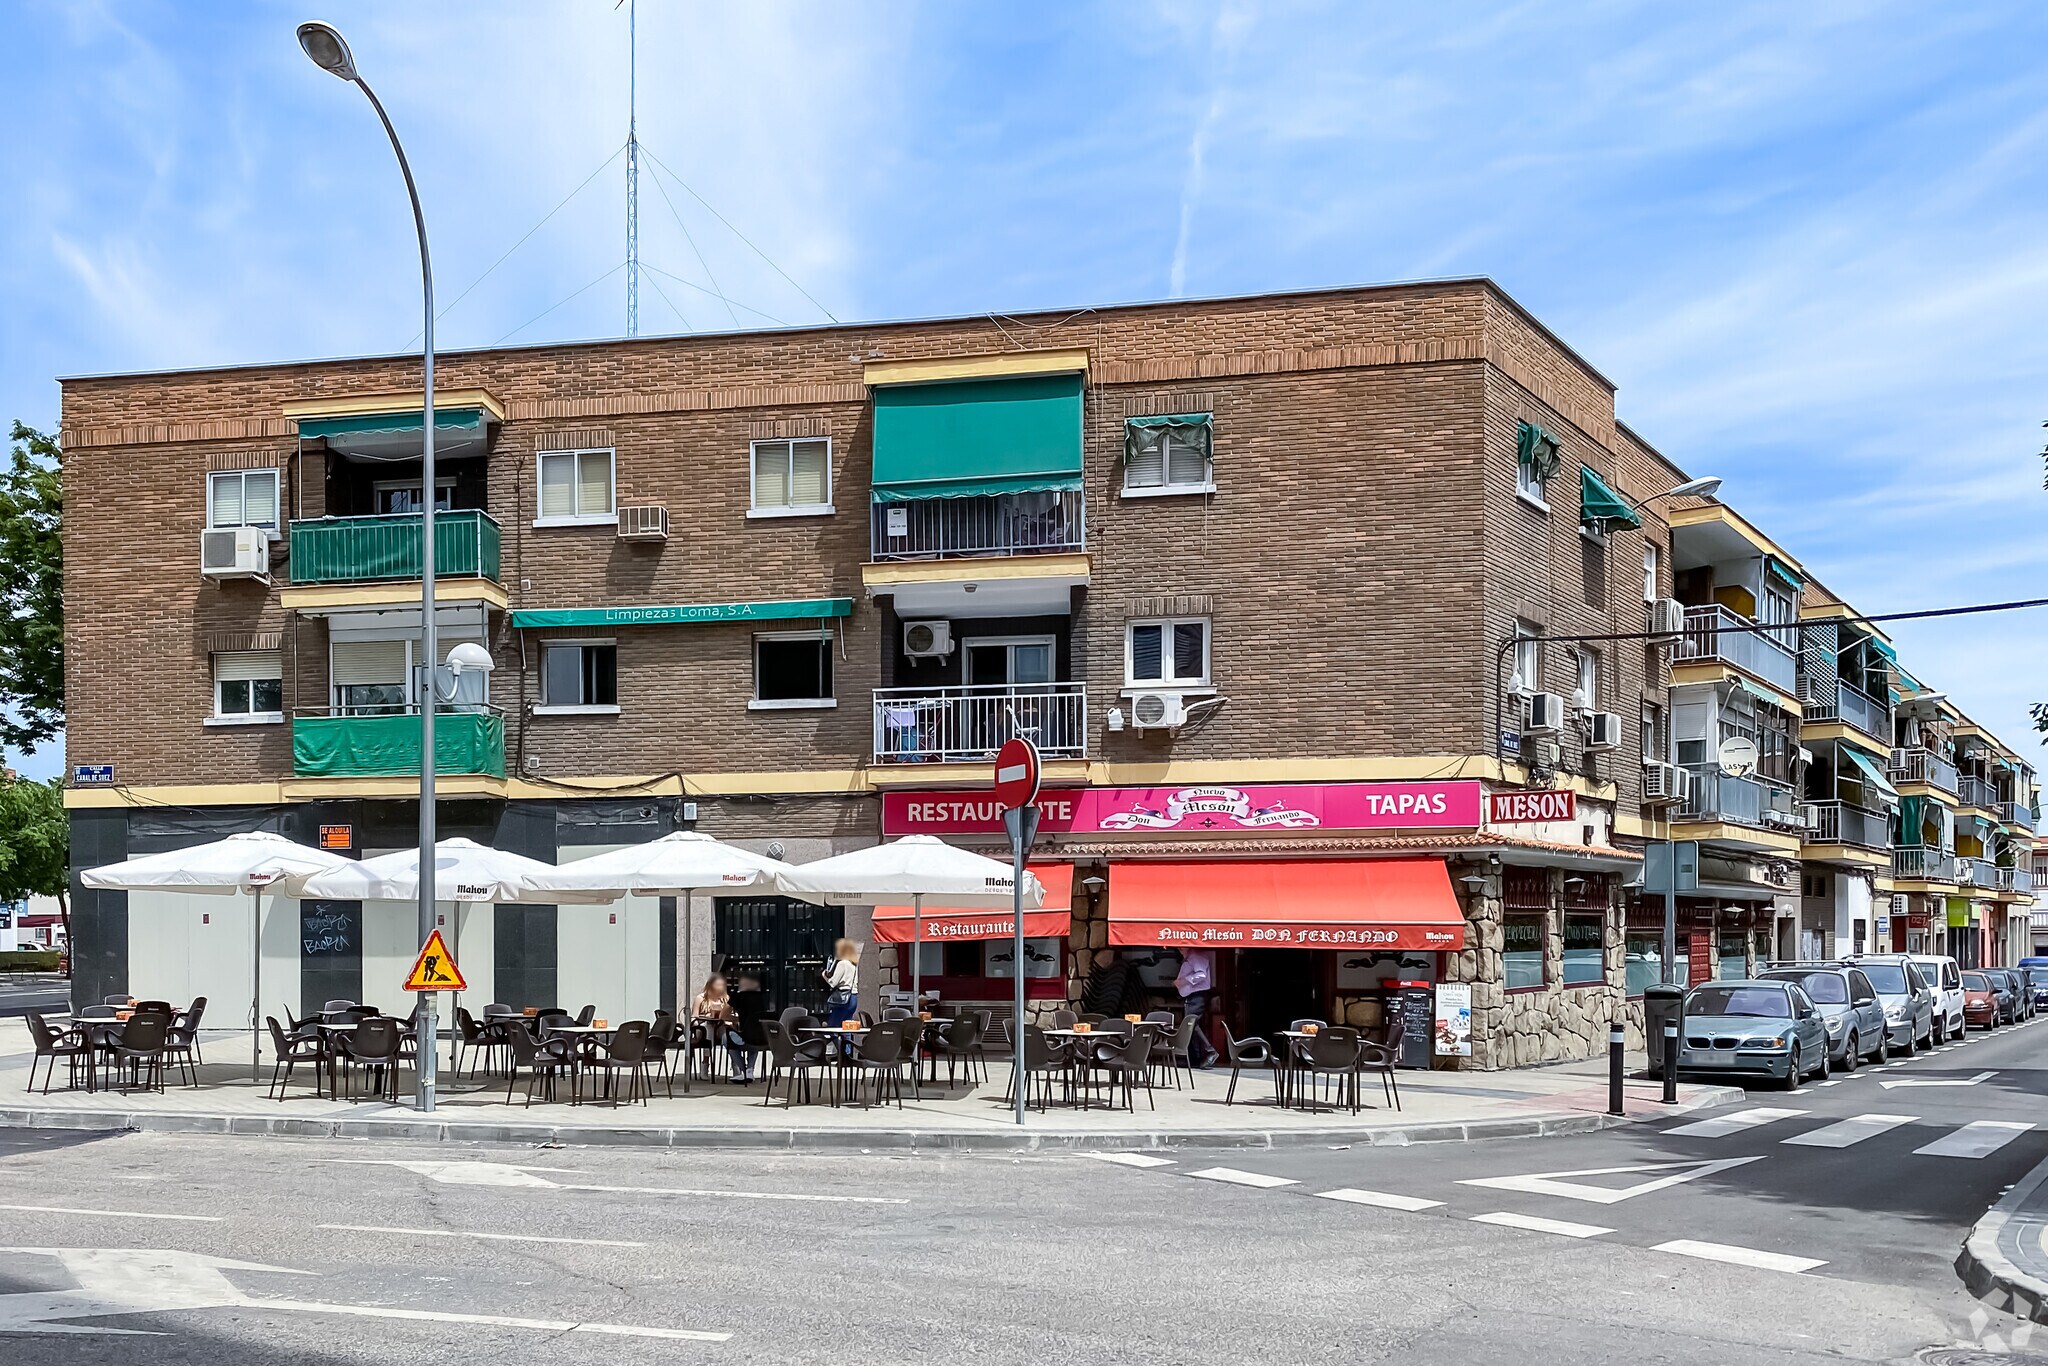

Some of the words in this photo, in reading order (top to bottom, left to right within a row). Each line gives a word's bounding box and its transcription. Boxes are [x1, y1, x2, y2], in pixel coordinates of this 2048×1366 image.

[606, 609, 676, 622] Limpiezas
[680, 606, 724, 618] Loma,
[728, 604, 757, 616] S.A.
[1193, 789, 1226, 797] Nuevo
[908, 801, 1071, 822] RESTAURTE
[1366, 793, 1447, 815] TAPAS
[1494, 793, 1570, 821] MESON
[1127, 814, 1151, 825] Don
[1253, 810, 1300, 826] Fernando
[457, 885, 488, 894] Mahou
[984, 877, 1016, 887] Maho
[927, 920, 1016, 937] Restaurante
[1157, 926, 1199, 941] Nuevo
[1202, 927, 1244, 942] Mesón
[1252, 928, 1292, 942] DON
[1294, 929, 1399, 944] FERNANDO
[1425, 932, 1455, 940] Mahou
